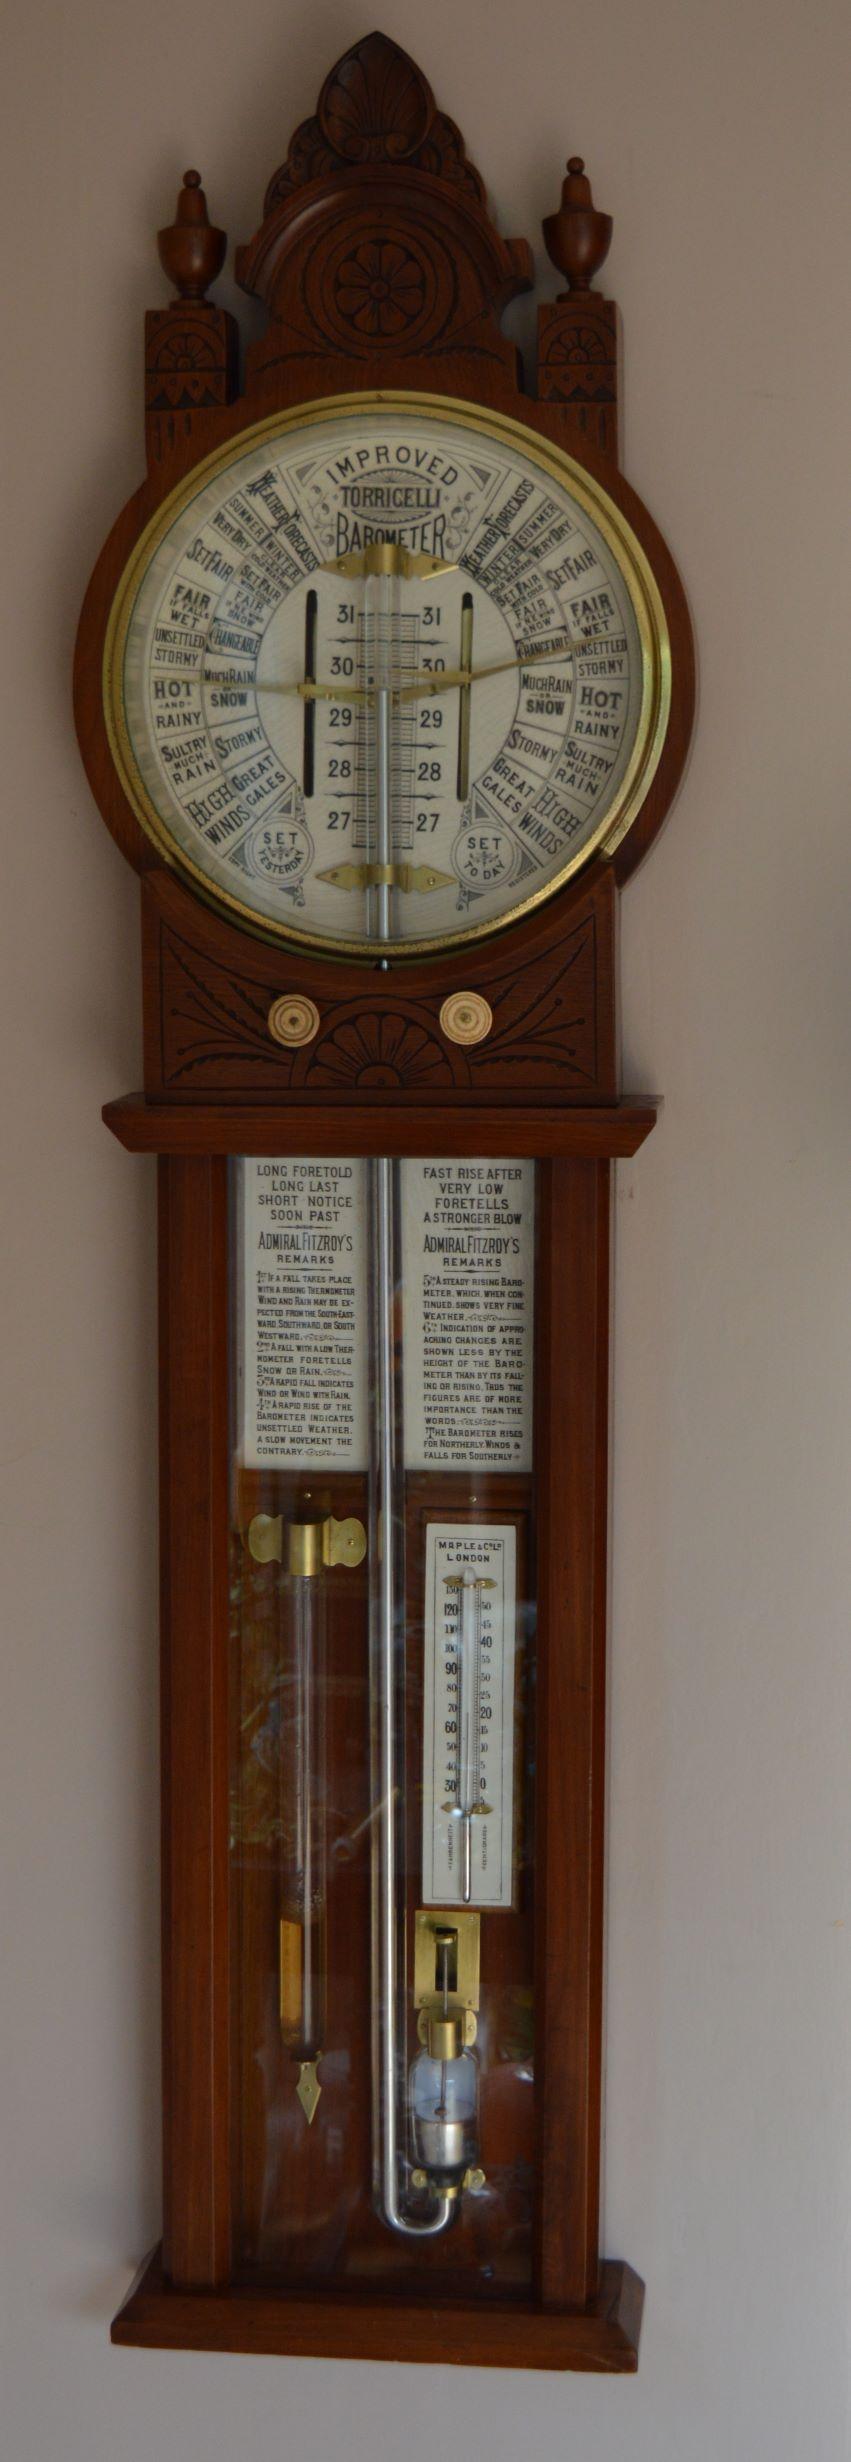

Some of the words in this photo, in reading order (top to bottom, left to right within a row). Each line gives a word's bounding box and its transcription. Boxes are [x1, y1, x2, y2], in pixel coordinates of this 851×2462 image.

[326, 445, 458, 486] IMPROVED
[340, 486, 442, 508] TORRICELLI
[246, 470, 290, 525] WEATHER
[272, 509, 321, 572] FORECASTS
[459, 527, 500, 578] WEATHER
[483, 479, 535, 540] FORECASTS
[213, 511, 236, 536] VERY
[231, 529, 252, 551] DRY
[229, 498, 265, 537] SUMMER
[265, 540, 301, 580] WINTER
[336, 511, 446, 559] BAROMETER
[528, 535, 554, 559] VERY
[552, 520, 572, 542] DRY
[480, 544, 519, 586] WINTER
[518, 502, 560, 544] SUMMER
[203, 550, 234, 581] FAIR
[545, 564, 571, 591] SET
[564, 550, 597, 580] FAIR
[241, 564, 259, 585] SET
[258, 578, 281, 601] FAIR
[173, 584, 211, 609] FAIR
[235, 591, 265, 612] FAIR
[570, 593, 612, 617] FAIR
[337, 605, 354, 623] 31
[422, 606, 440, 626] 31
[514, 598, 547, 620] FAIR
[170, 610, 200, 628] WET
[523, 617, 551, 636] SNOW
[581, 620, 610, 637] WET
[155, 628, 206, 649] UNSETTLED
[575, 639, 628, 657] UNSETTLED
[154, 648, 199, 667] STORMY
[330, 657, 353, 676] 30
[422, 658, 446, 674] 30
[229, 668, 257, 685] RAIN
[578, 659, 623, 676] STORMY
[154, 681, 193, 699] HOT
[521, 674, 548, 690] MUCH
[548, 675, 573, 694] RAIN
[210, 693, 248, 708] SNOW
[526, 699, 565, 715] SNOW
[580, 686, 623, 710] HOT
[156, 712, 202, 728] RAINY
[329, 708, 351, 727] 29
[420, 710, 442, 728] 29
[574, 721, 619, 739] RAINY
[160, 735, 208, 763] SULTRY
[214, 726, 264, 760] STORMY
[507, 730, 559, 763] STORMY
[173, 752, 204, 770] MUCH
[564, 740, 614, 773] SULTRY
[172, 760, 217, 786] RAIN
[231, 755, 275, 792] GREAT
[328, 760, 351, 778] 28
[418, 762, 441, 781] 28
[492, 758, 535, 798] GREAT
[566, 760, 598, 779] MUCH
[246, 771, 286, 806] GALES
[555, 768, 599, 796] RAIN
[482, 776, 522, 813] GALES
[185, 782, 235, 829] HIGH
[533, 786, 582, 836] HIGH
[204, 805, 250, 846] WINDS
[327, 812, 350, 830] 27
[416, 813, 440, 832] 27
[263, 832, 298, 844] SET
[518, 812, 563, 854] WINDS
[468, 837, 501, 849] SET
[258, 849, 305, 875] YESTERDAY
[464, 861, 478, 877] TO
[483, 862, 506, 880] DAY
[257, 1165, 287, 1176] LONG
[293, 1166, 352, 1178] FORETOLD
[423, 1168, 452, 1179] FAST
[458, 1168, 484, 1180] RISE
[487, 1169, 522, 1180] AFTER
[272, 1181, 303, 1191] LONG
[309, 1182, 339, 1192] LAST
[440, 1183, 472, 1194] VERY
[478, 1184, 504, 1195] LOW
[258, 1195, 298, 1206] SHORT
[308, 1197, 352, 1207] NOTICE
[435, 1198, 509, 1209] FORETELLS
[271, 1210, 302, 1221] SOON
[309, 1211, 340, 1221] PAST
[423, 1212, 431, 1223] A
[433, 1213, 490, 1224] STRONGER
[494, 1213, 522, 1224] BLOW
[258, 1231, 302, 1250] ADMIRAL
[302, 1232, 353, 1251] FITZROY'S
[424, 1234, 467, 1253] ADMIRAL
[467, 1235, 520, 1255] FITZROY'S
[277, 1254, 334, 1264] REMARKS
[443, 1258, 502, 1267] REMARKS
[329, 1276, 352, 1284] PLACE
[442, 1278, 470, 1286] STEADY
[440, 1323, 484, 1332] INDICATION
[455, 1336, 496, 1344] CHANGES
[502, 1337, 522, 1345] ARE
[423, 1348, 454, 1356] SHOWN
[459, 1348, 484, 1356] LESS
[505, 1349, 523, 1357] THE
[257, 1365, 282, 1374] SNOW
[286, 1366, 297, 1374] OR
[423, 1359, 454, 1367] HEIGHT
[423, 1371, 452, 1379] METER
[455, 1371, 475, 1379] THAN
[336, 1403, 352, 1411] THE
[423, 1394, 460, 1402] FIGURES
[257, 1412, 306, 1421] BAROMETER
[310, 1414, 354, 1422] INDICATES
[424, 1406, 477, 1414] IMPORTANCE
[481, 1407, 504, 1415] THAN
[506, 1407, 523, 1415] THE
[257, 1425, 303, 1433] UNSETTLED
[447, 1428, 496, 1437] BAROMETER
[289, 1437, 332, 1445] MOVEMENT
[439, 1440, 485, 1449] NORTHERLY
[485, 1441, 511, 1449] WINDS
[424, 1452, 448, 1460] FALLS
[469, 1451, 512, 1461] SOUTHERLY
[438, 1541, 476, 1550] MAPLE
[446, 1553, 490, 1562] LONDON
[444, 1603, 458, 1616] 120
[480, 1636, 492, 1648] 40
[445, 1662, 457, 1675] 90
[446, 1683, 457, 1693] 80
[448, 1703, 457, 1713] 70
[480, 1706, 492, 1719] 20
[444, 1721, 457, 1734] 60
[444, 1779, 457, 1792] 30
[480, 1777, 486, 1790] 0
